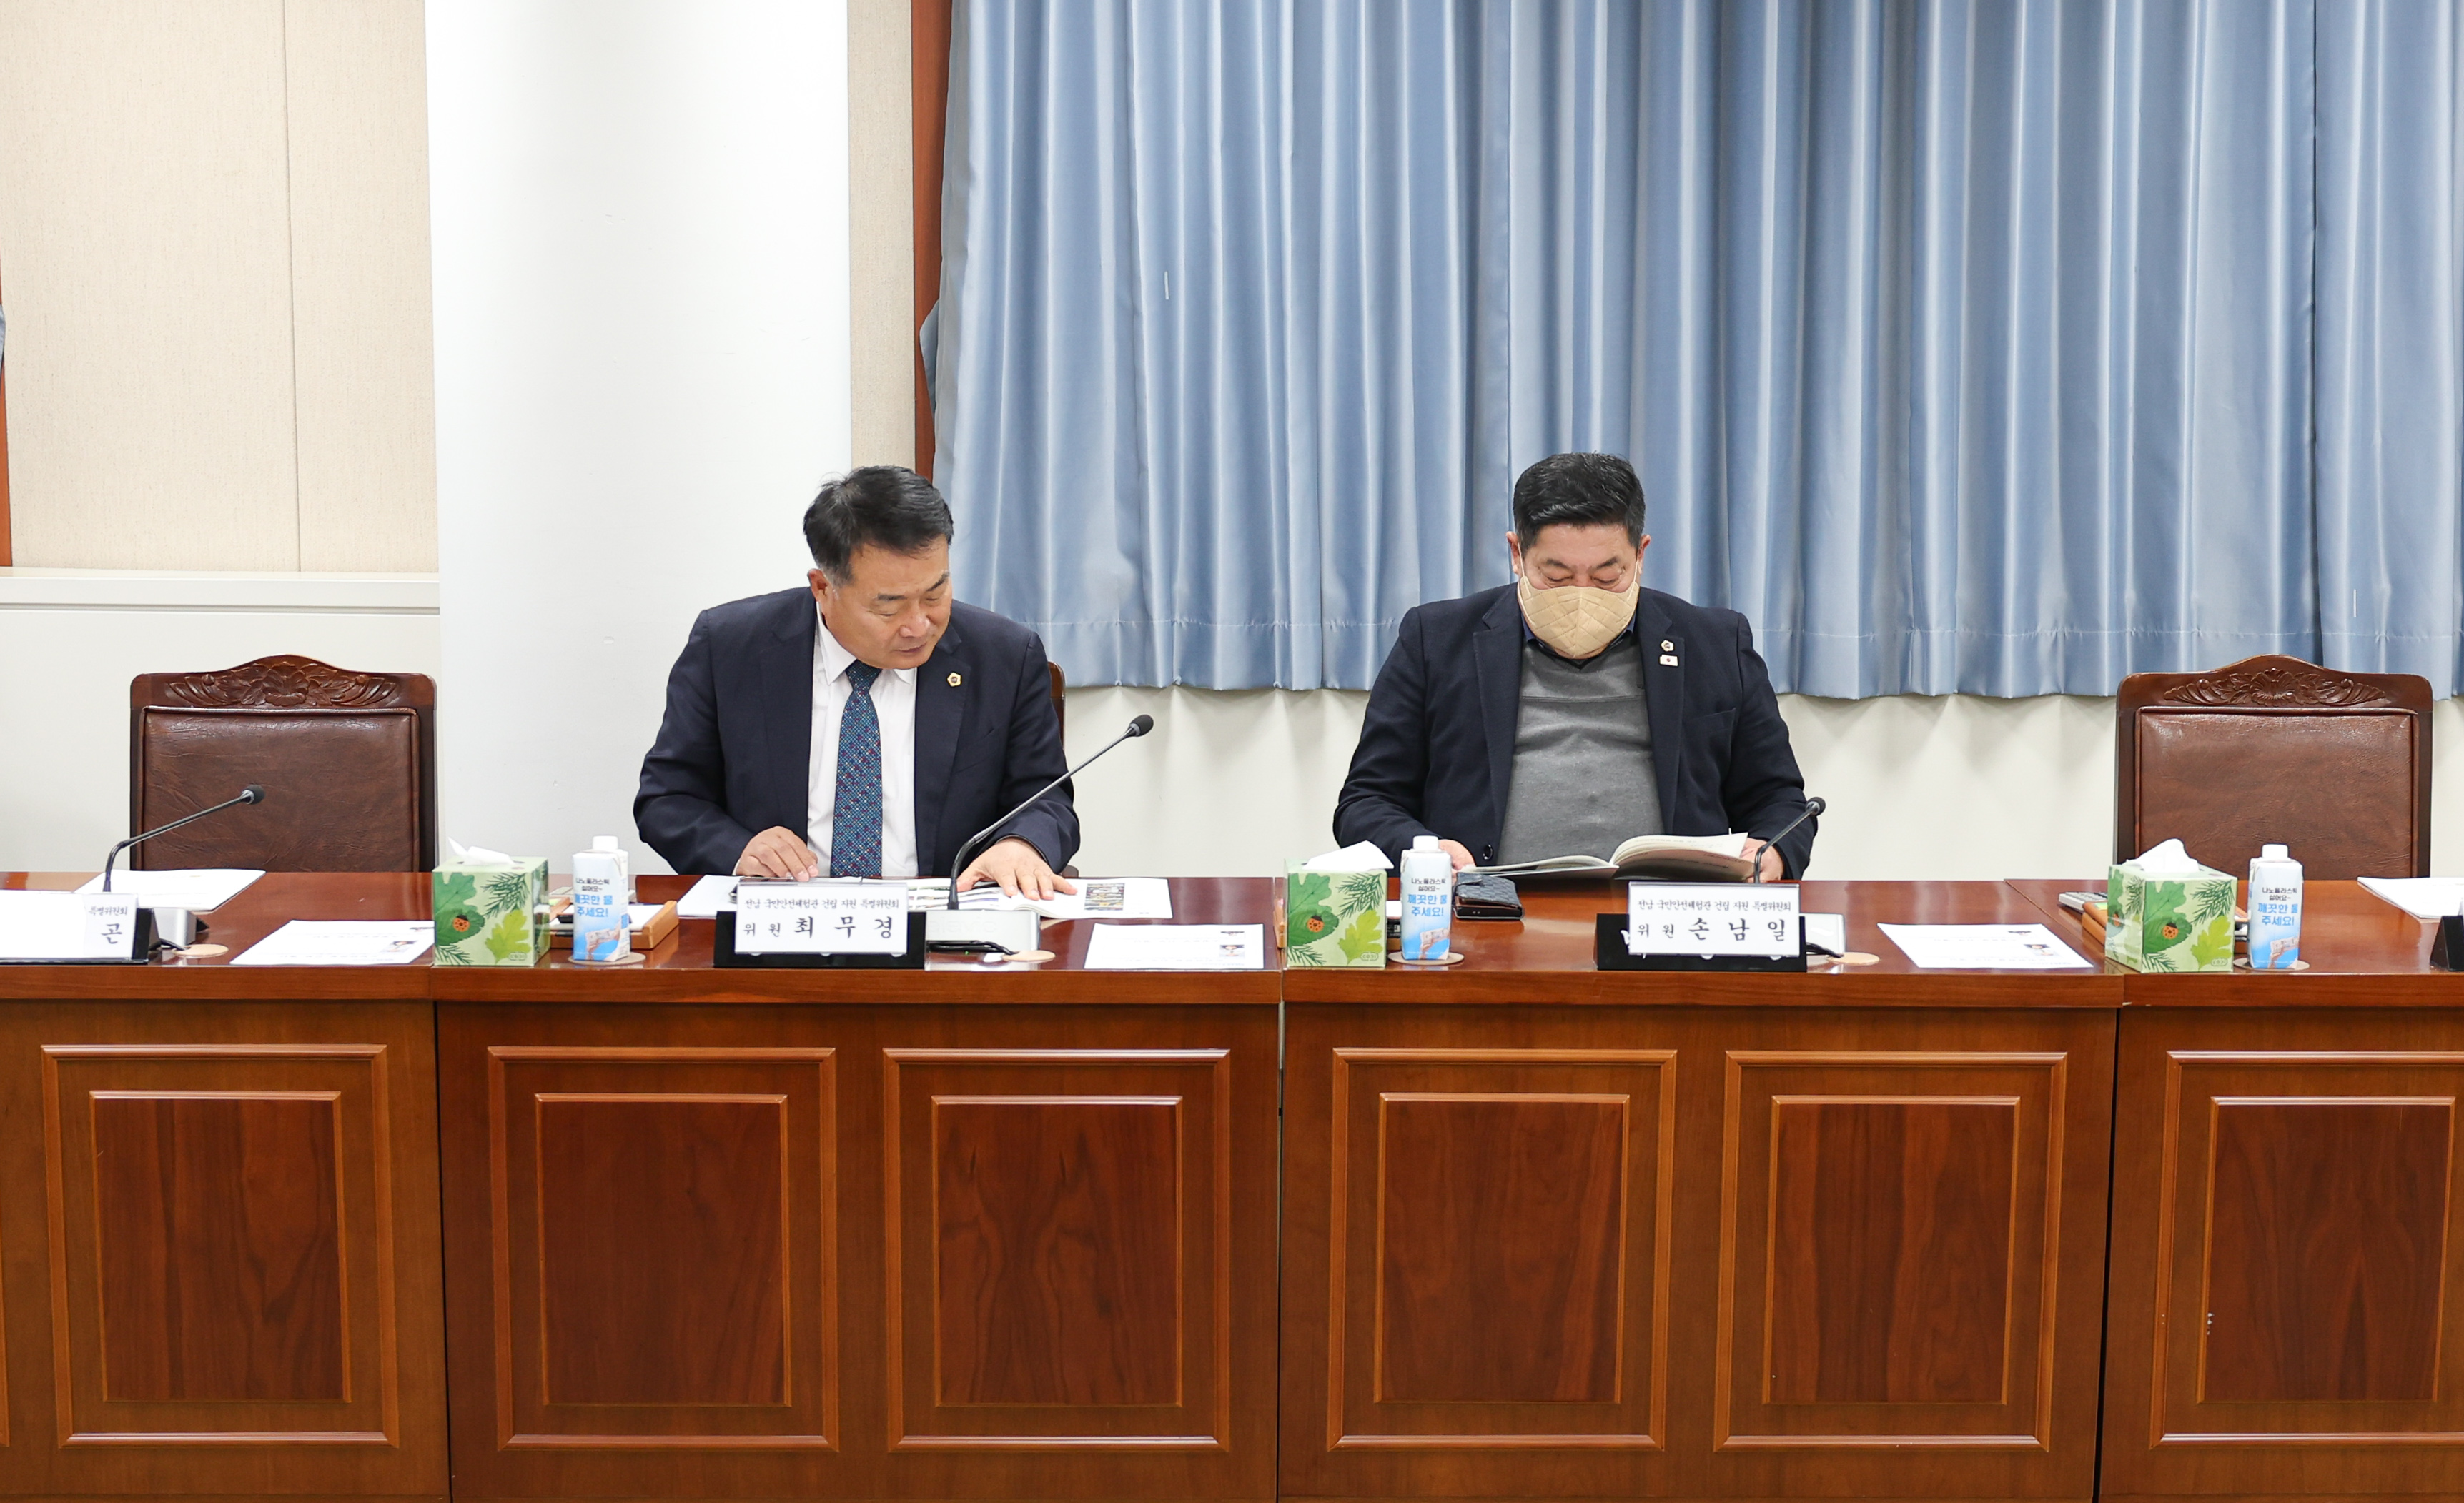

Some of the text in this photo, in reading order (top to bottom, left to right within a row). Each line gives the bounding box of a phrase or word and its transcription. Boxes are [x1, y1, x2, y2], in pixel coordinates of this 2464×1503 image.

[603, 895, 613, 906] 물
[745, 898, 899, 909] 전남 국민안전체험관 건립 지원 특별위원회
[1407, 893, 1448, 905] 깨끗한 물
[1638, 899, 1791, 912] 전남 국민안전체험관 건립 지원 특별위원회
[2257, 903, 2298, 914] 깨끗한 물
[577, 906, 608, 917] 주세요!
[1411, 906, 1444, 917] 주세요!
[2262, 916, 2295, 926] 주세요!
[101, 923, 122, 944] 곤
